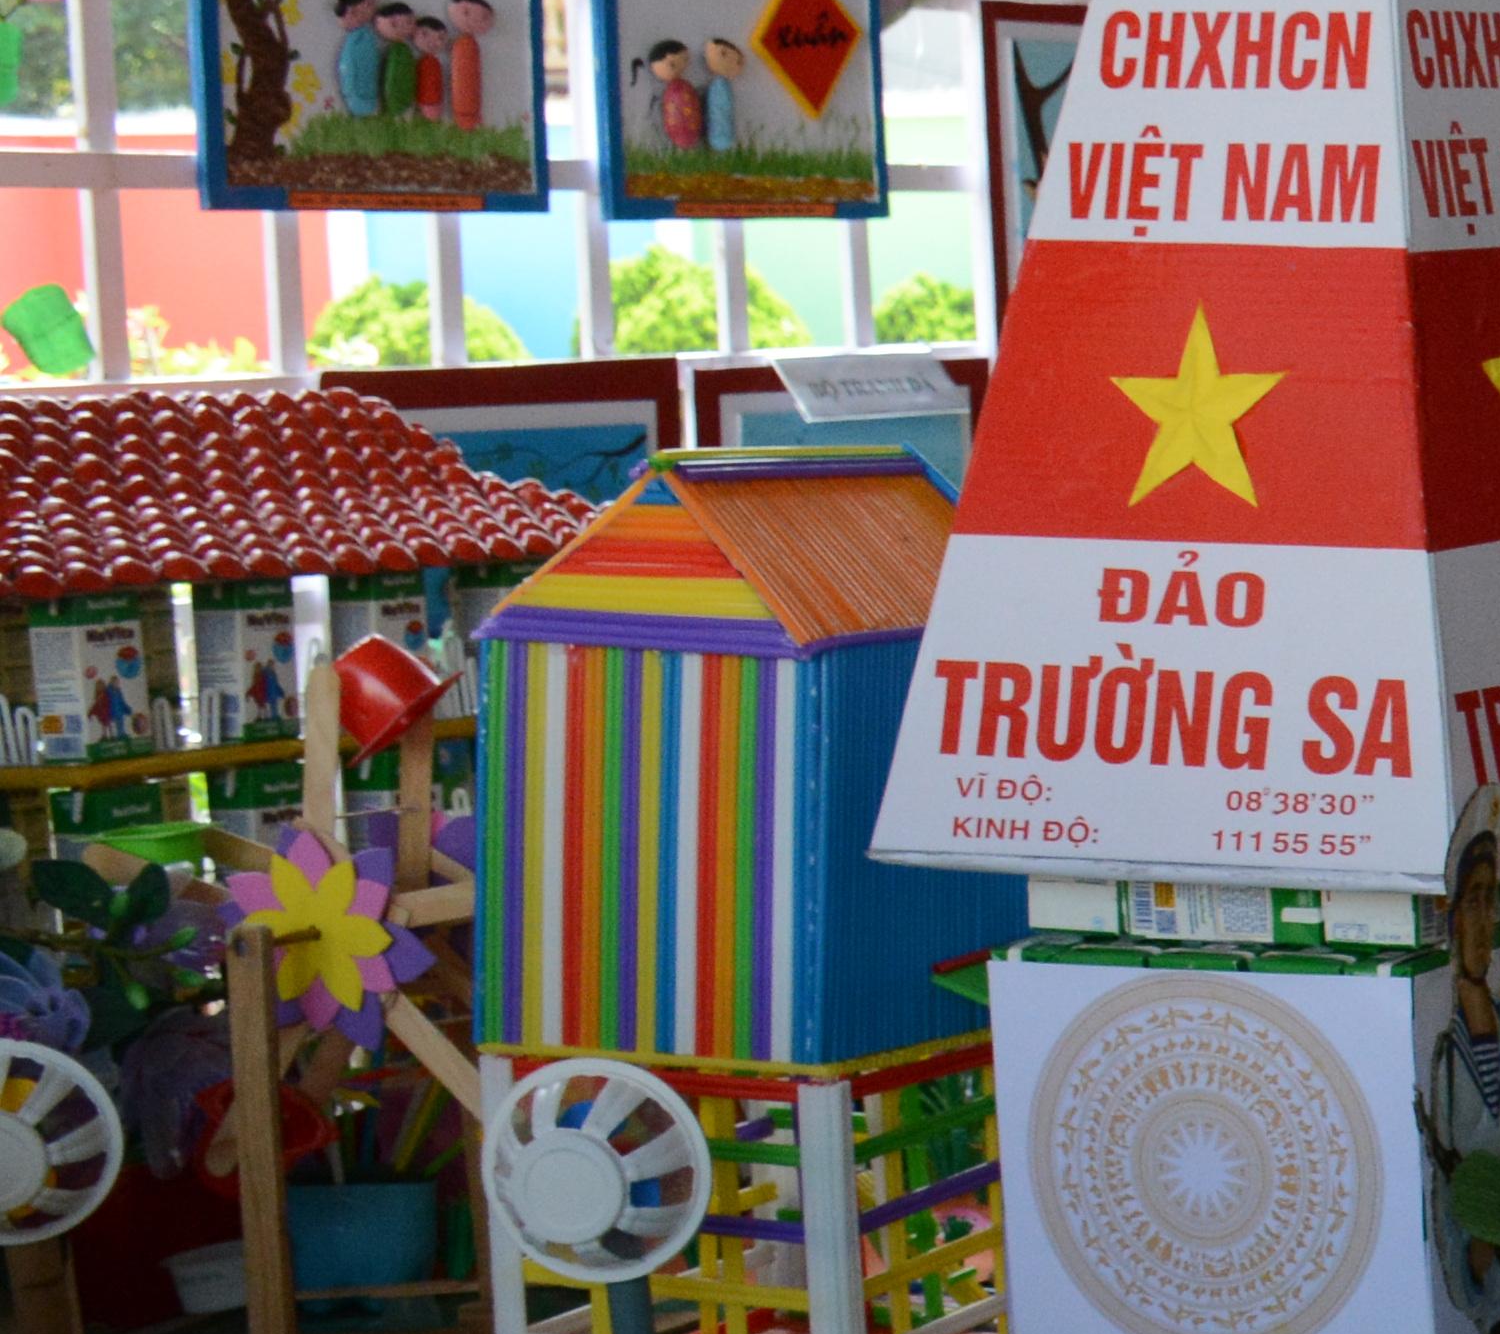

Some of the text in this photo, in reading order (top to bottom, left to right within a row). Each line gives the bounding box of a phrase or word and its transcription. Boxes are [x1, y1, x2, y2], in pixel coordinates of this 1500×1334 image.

[1100, 10, 1373, 91] CHXHCN
[1068, 124, 1381, 237] VIỆT NAM
[1411, 120, 1495, 237] VIỆT
[1097, 549, 1266, 629] ĐẢO
[935, 642, 1413, 779] TRƯỜNG SA
[956, 772, 986, 800] VĨ
[996, 773, 1053, 804] ĐỘ:
[951, 816, 1031, 841] KINH
[1043, 817, 1100, 849] ĐỘ:
